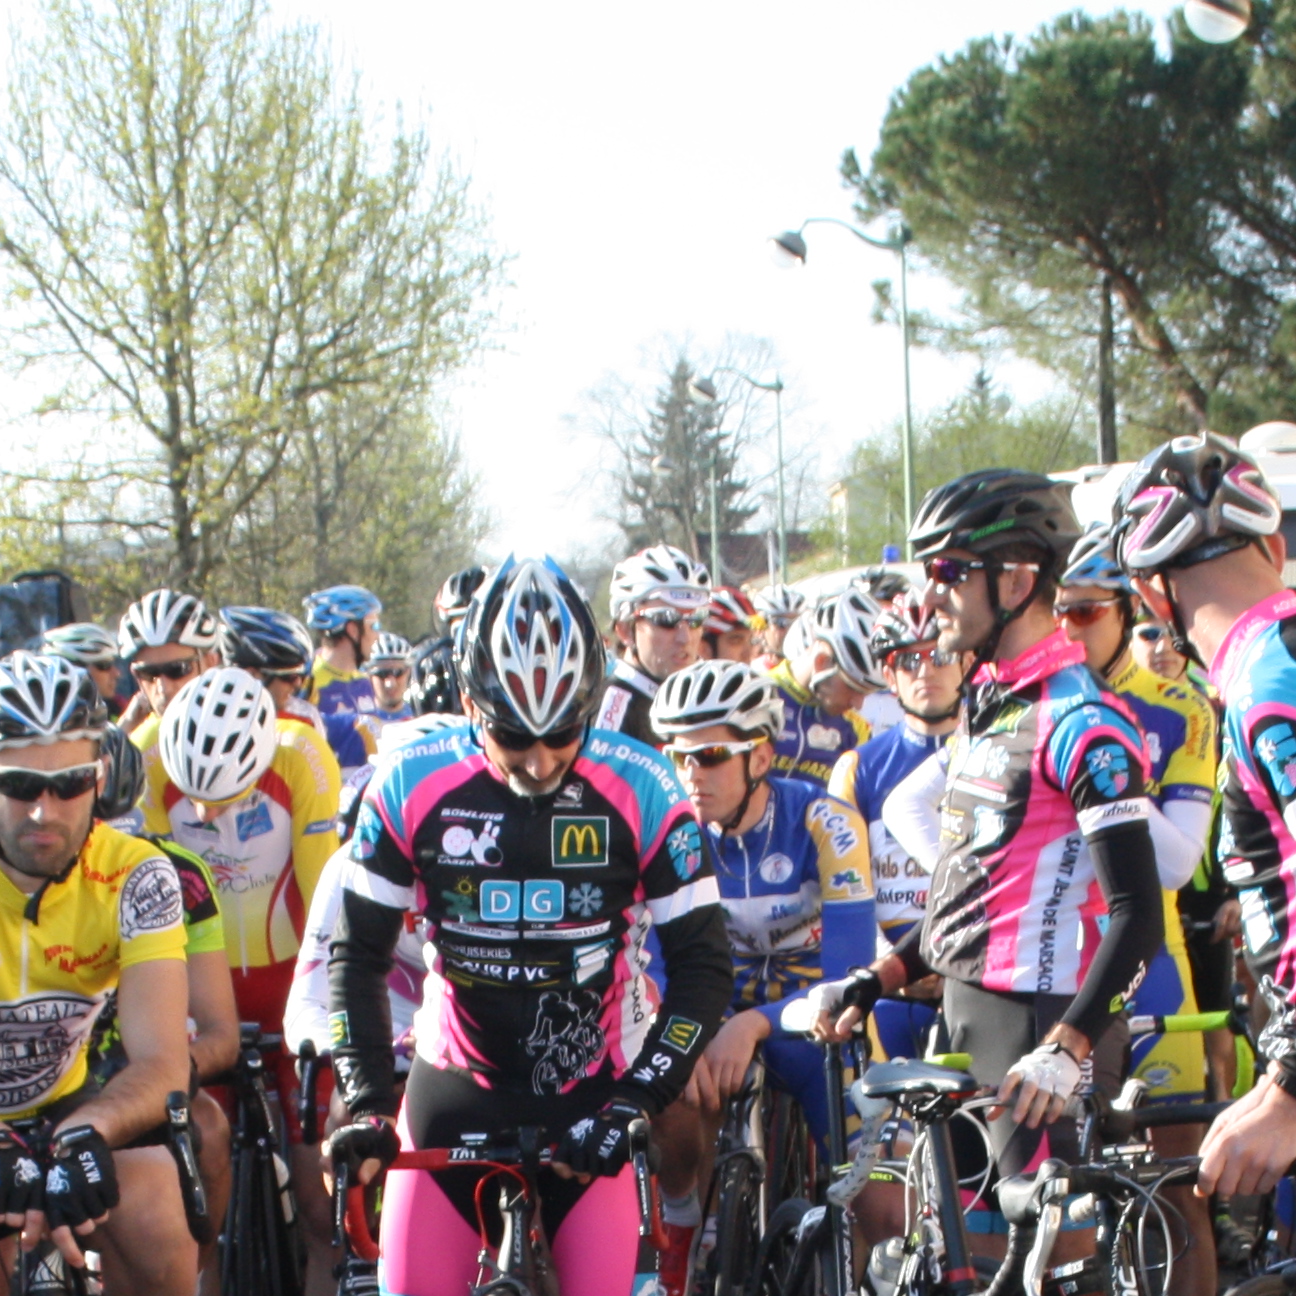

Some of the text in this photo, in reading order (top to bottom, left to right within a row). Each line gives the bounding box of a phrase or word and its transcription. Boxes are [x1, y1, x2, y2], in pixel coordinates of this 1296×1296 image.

[589, 737, 680, 805] McDonald's
[439, 807, 504, 822] BOWLING
[490, 889, 552, 914] D G
[514, 1210, 524, 1264] LOOK
